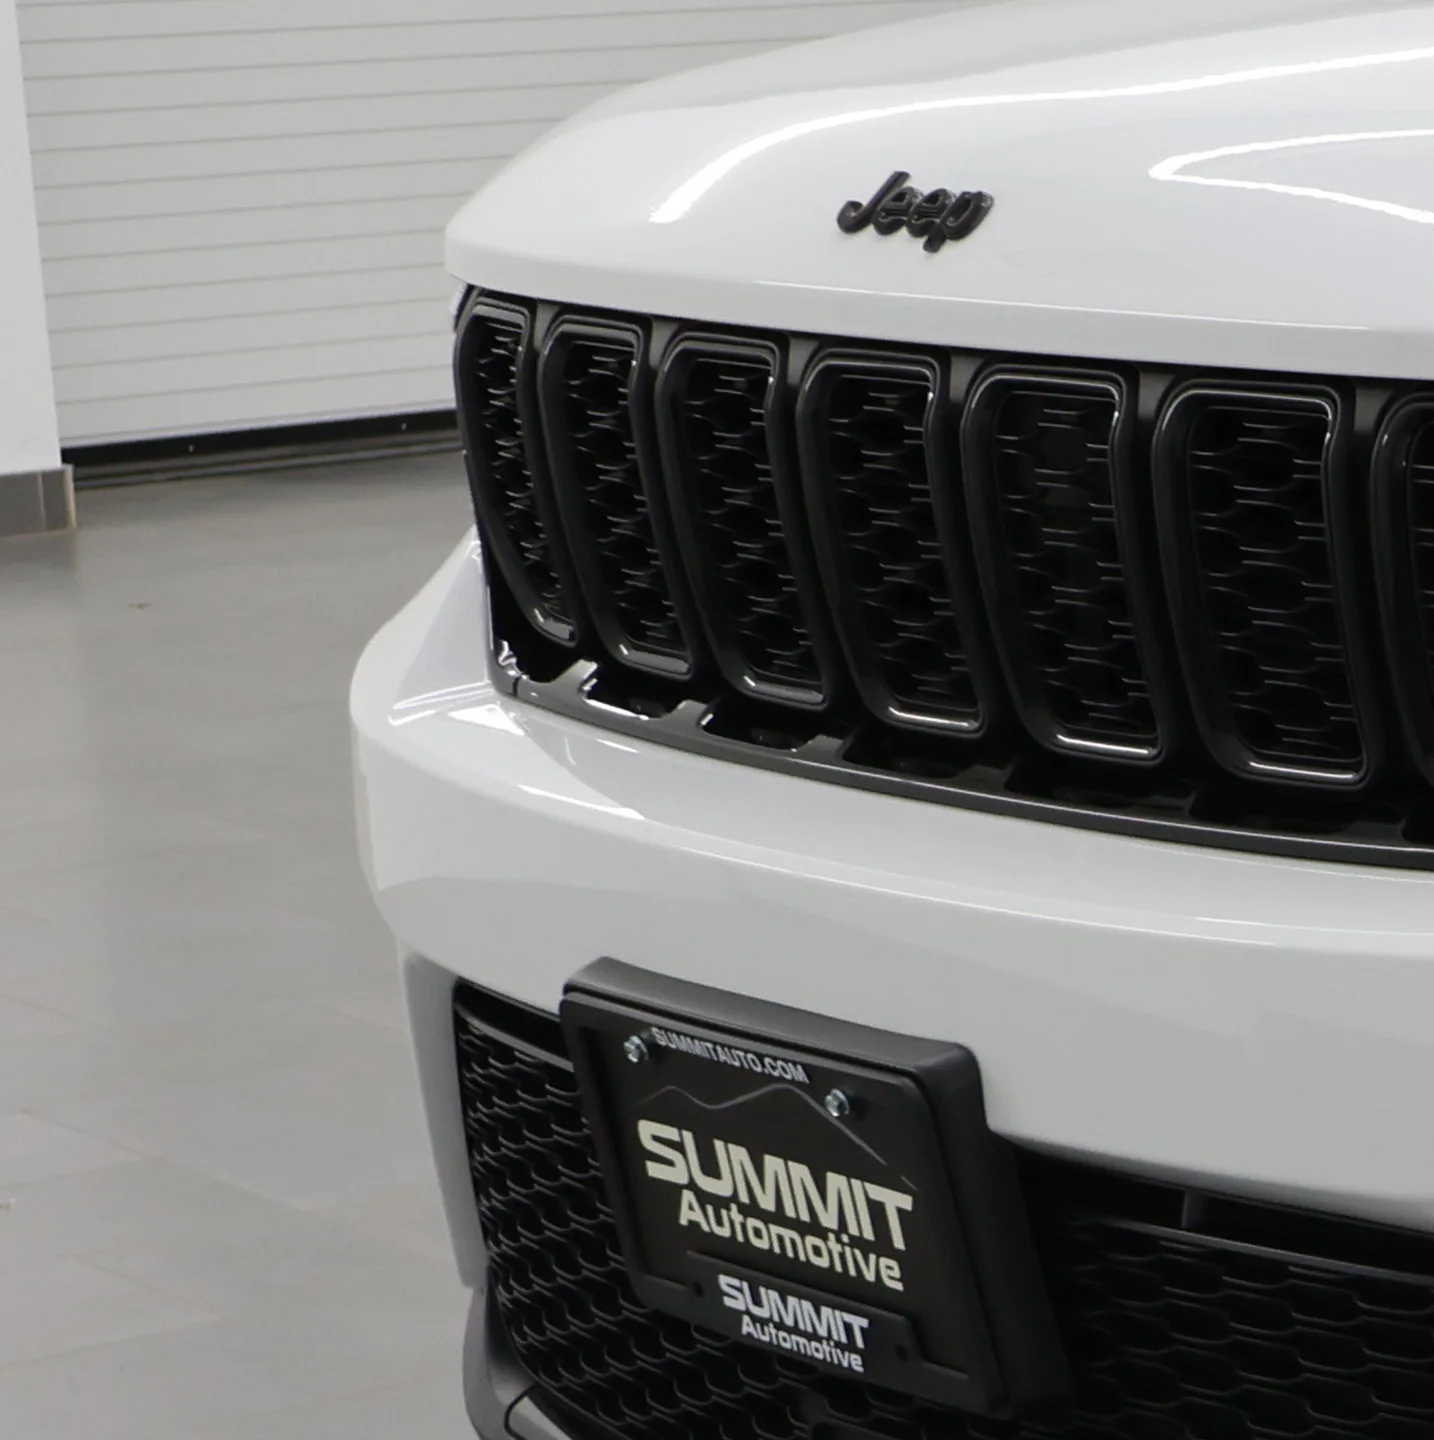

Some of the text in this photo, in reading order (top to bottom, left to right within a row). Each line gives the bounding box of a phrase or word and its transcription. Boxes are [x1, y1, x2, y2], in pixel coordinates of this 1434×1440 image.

[837, 171, 994, 253] Jeep
[653, 1027, 810, 1084] SUMMITAUTO.COM
[638, 1119, 913, 1250] SUMMIT
[679, 1188, 904, 1291] Automotive
[718, 1274, 868, 1349] SUMMIT
[741, 1314, 864, 1373] Automotive
